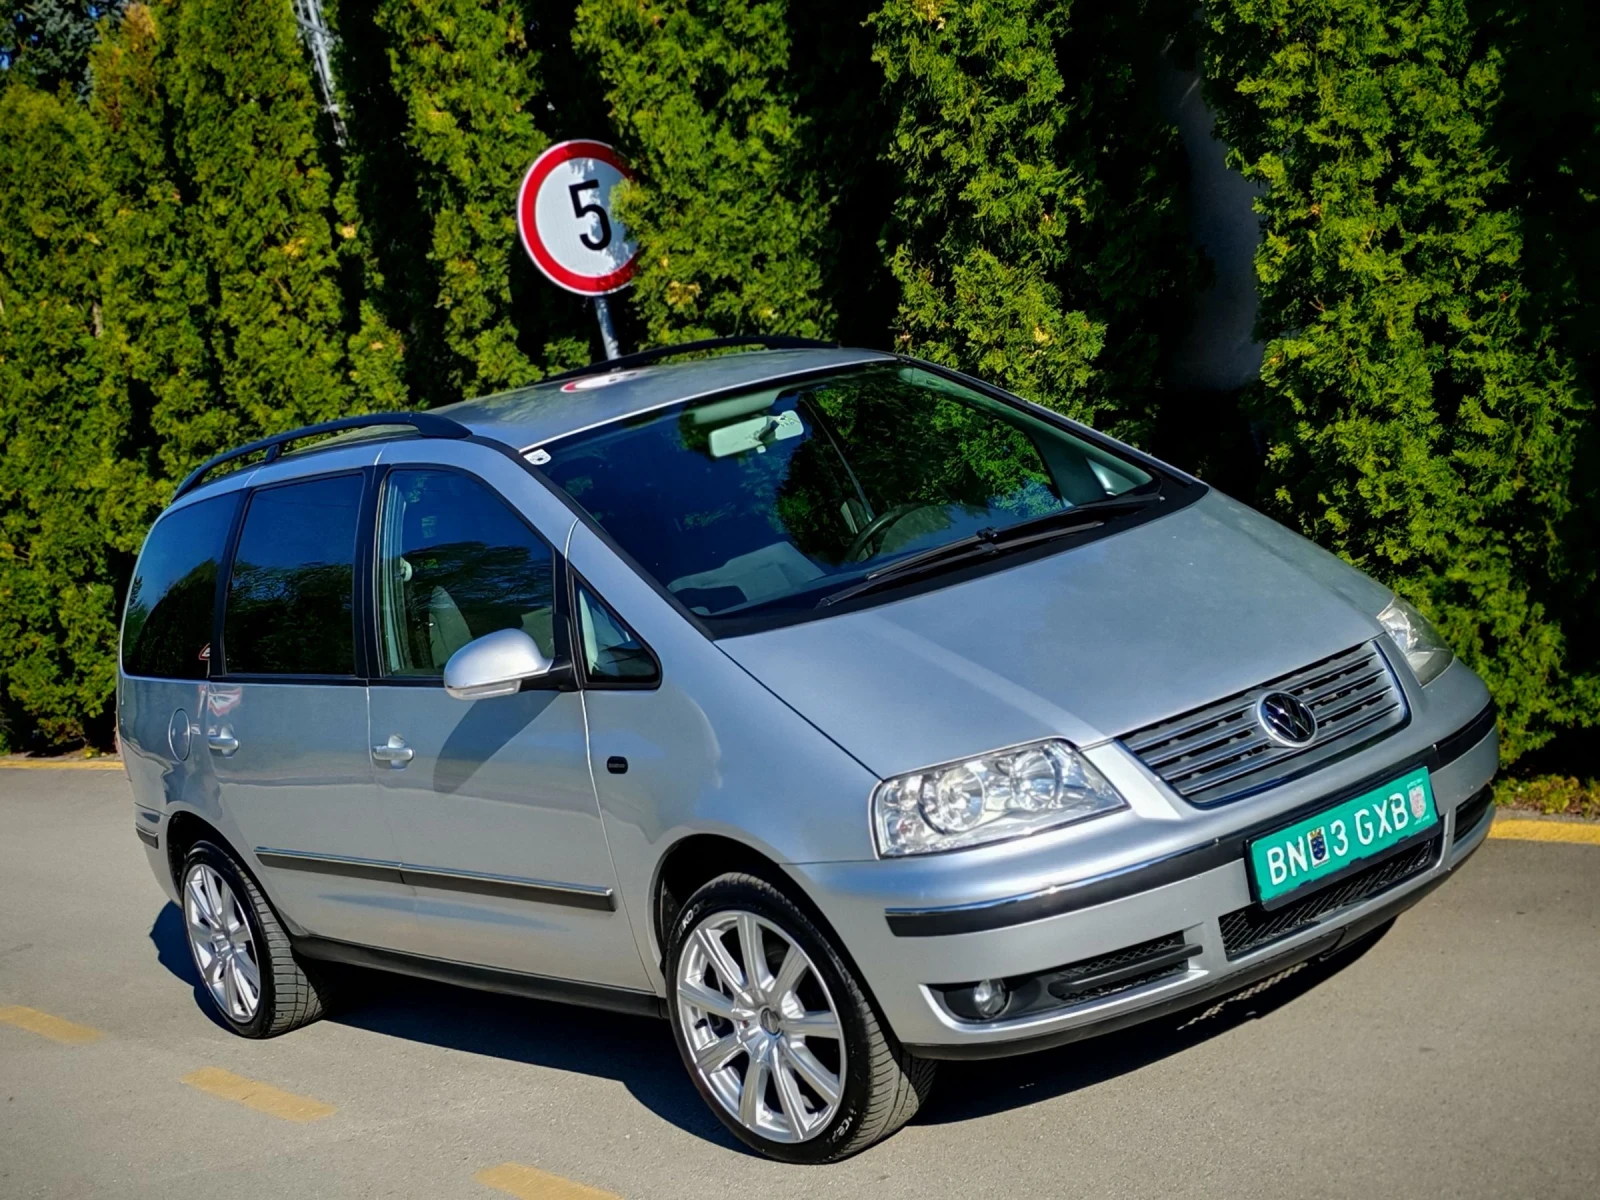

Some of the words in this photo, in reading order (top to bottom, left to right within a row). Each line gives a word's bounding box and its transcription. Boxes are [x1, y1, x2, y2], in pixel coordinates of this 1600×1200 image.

[568, 178, 612, 251] 5
[1266, 835, 1308, 886] BN
[1330, 819, 1349, 857] 3
[1354, 792, 1409, 846] GXB
